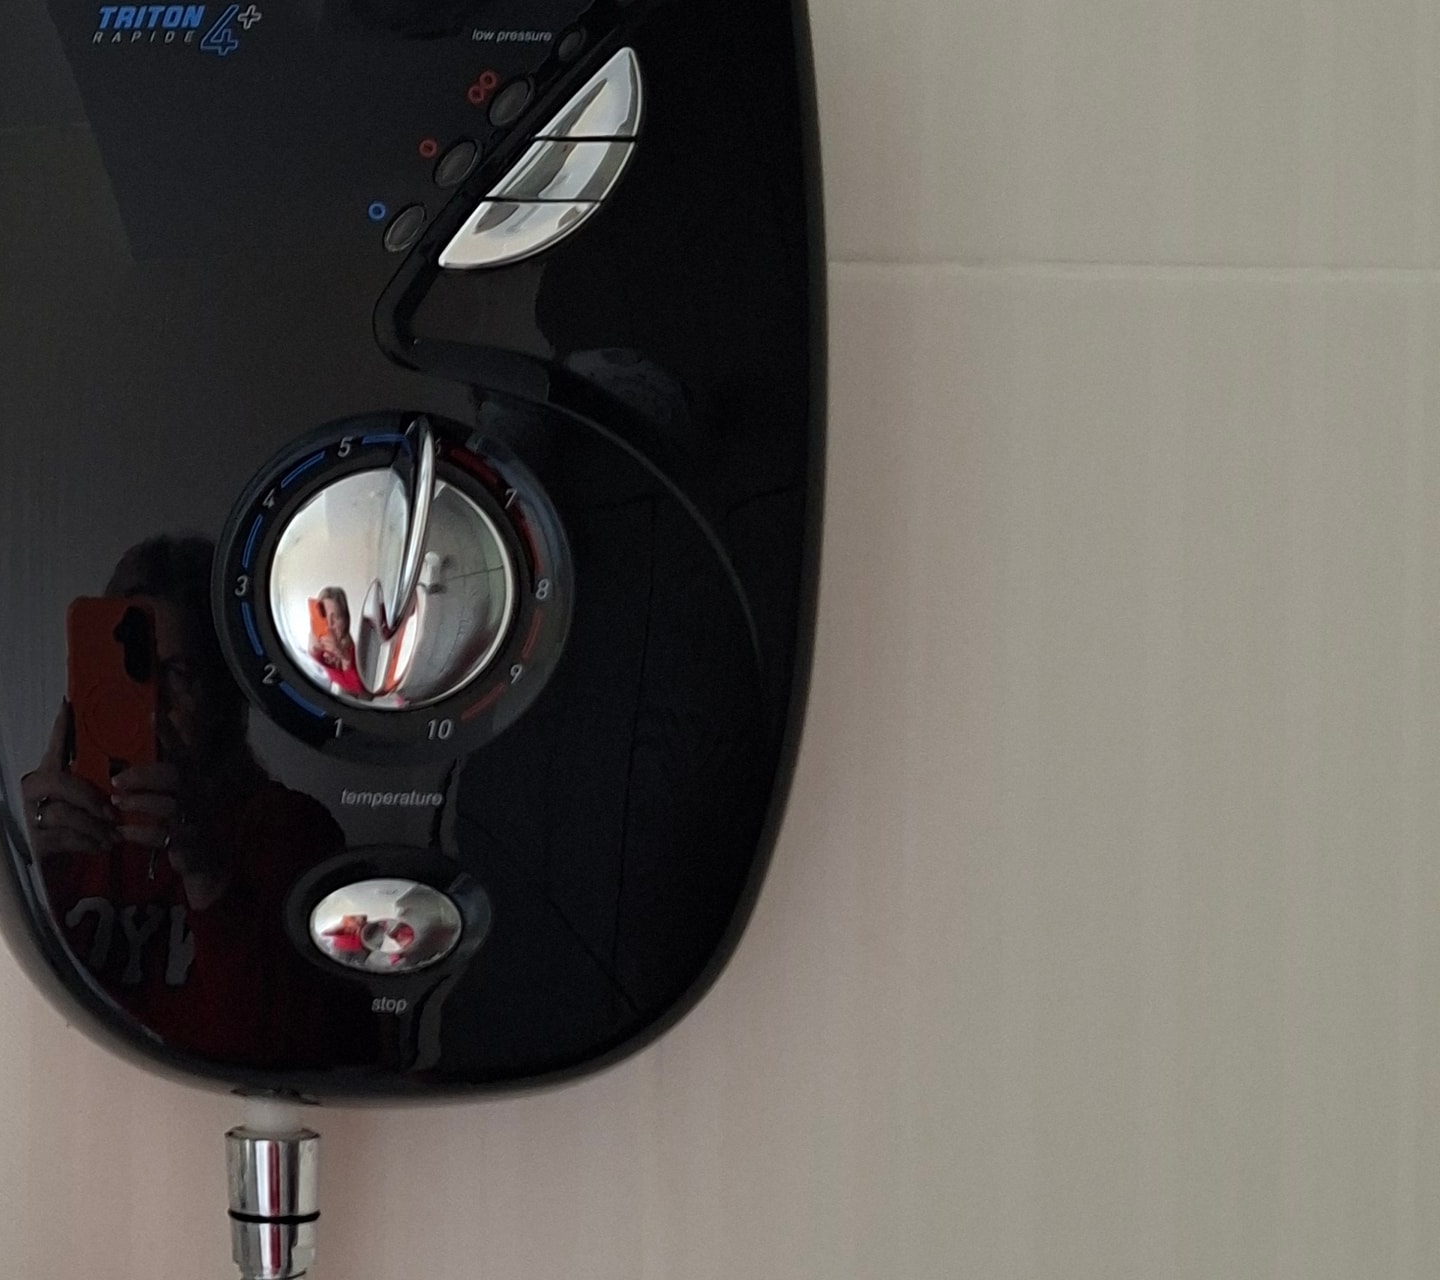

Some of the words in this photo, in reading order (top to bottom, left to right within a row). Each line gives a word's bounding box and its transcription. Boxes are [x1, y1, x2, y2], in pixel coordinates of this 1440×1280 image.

[98, 5, 206, 29] TRITON
[92, 30, 196, 44] RAPIDE
[472, 28, 495, 41] low
[496, 30, 553, 44] pressure
[337, 435, 353, 458] 5
[262, 488, 277, 508] 4
[503, 487, 518, 510] 7
[234, 575, 249, 597] 3
[535, 578, 550, 600] 8
[262, 663, 277, 685] 2
[510, 663, 523, 685] 9
[332, 718, 343, 738] 1
[427, 719, 453, 740] 10
[340, 788, 443, 808] temperature
[371, 996, 408, 1015] stop
